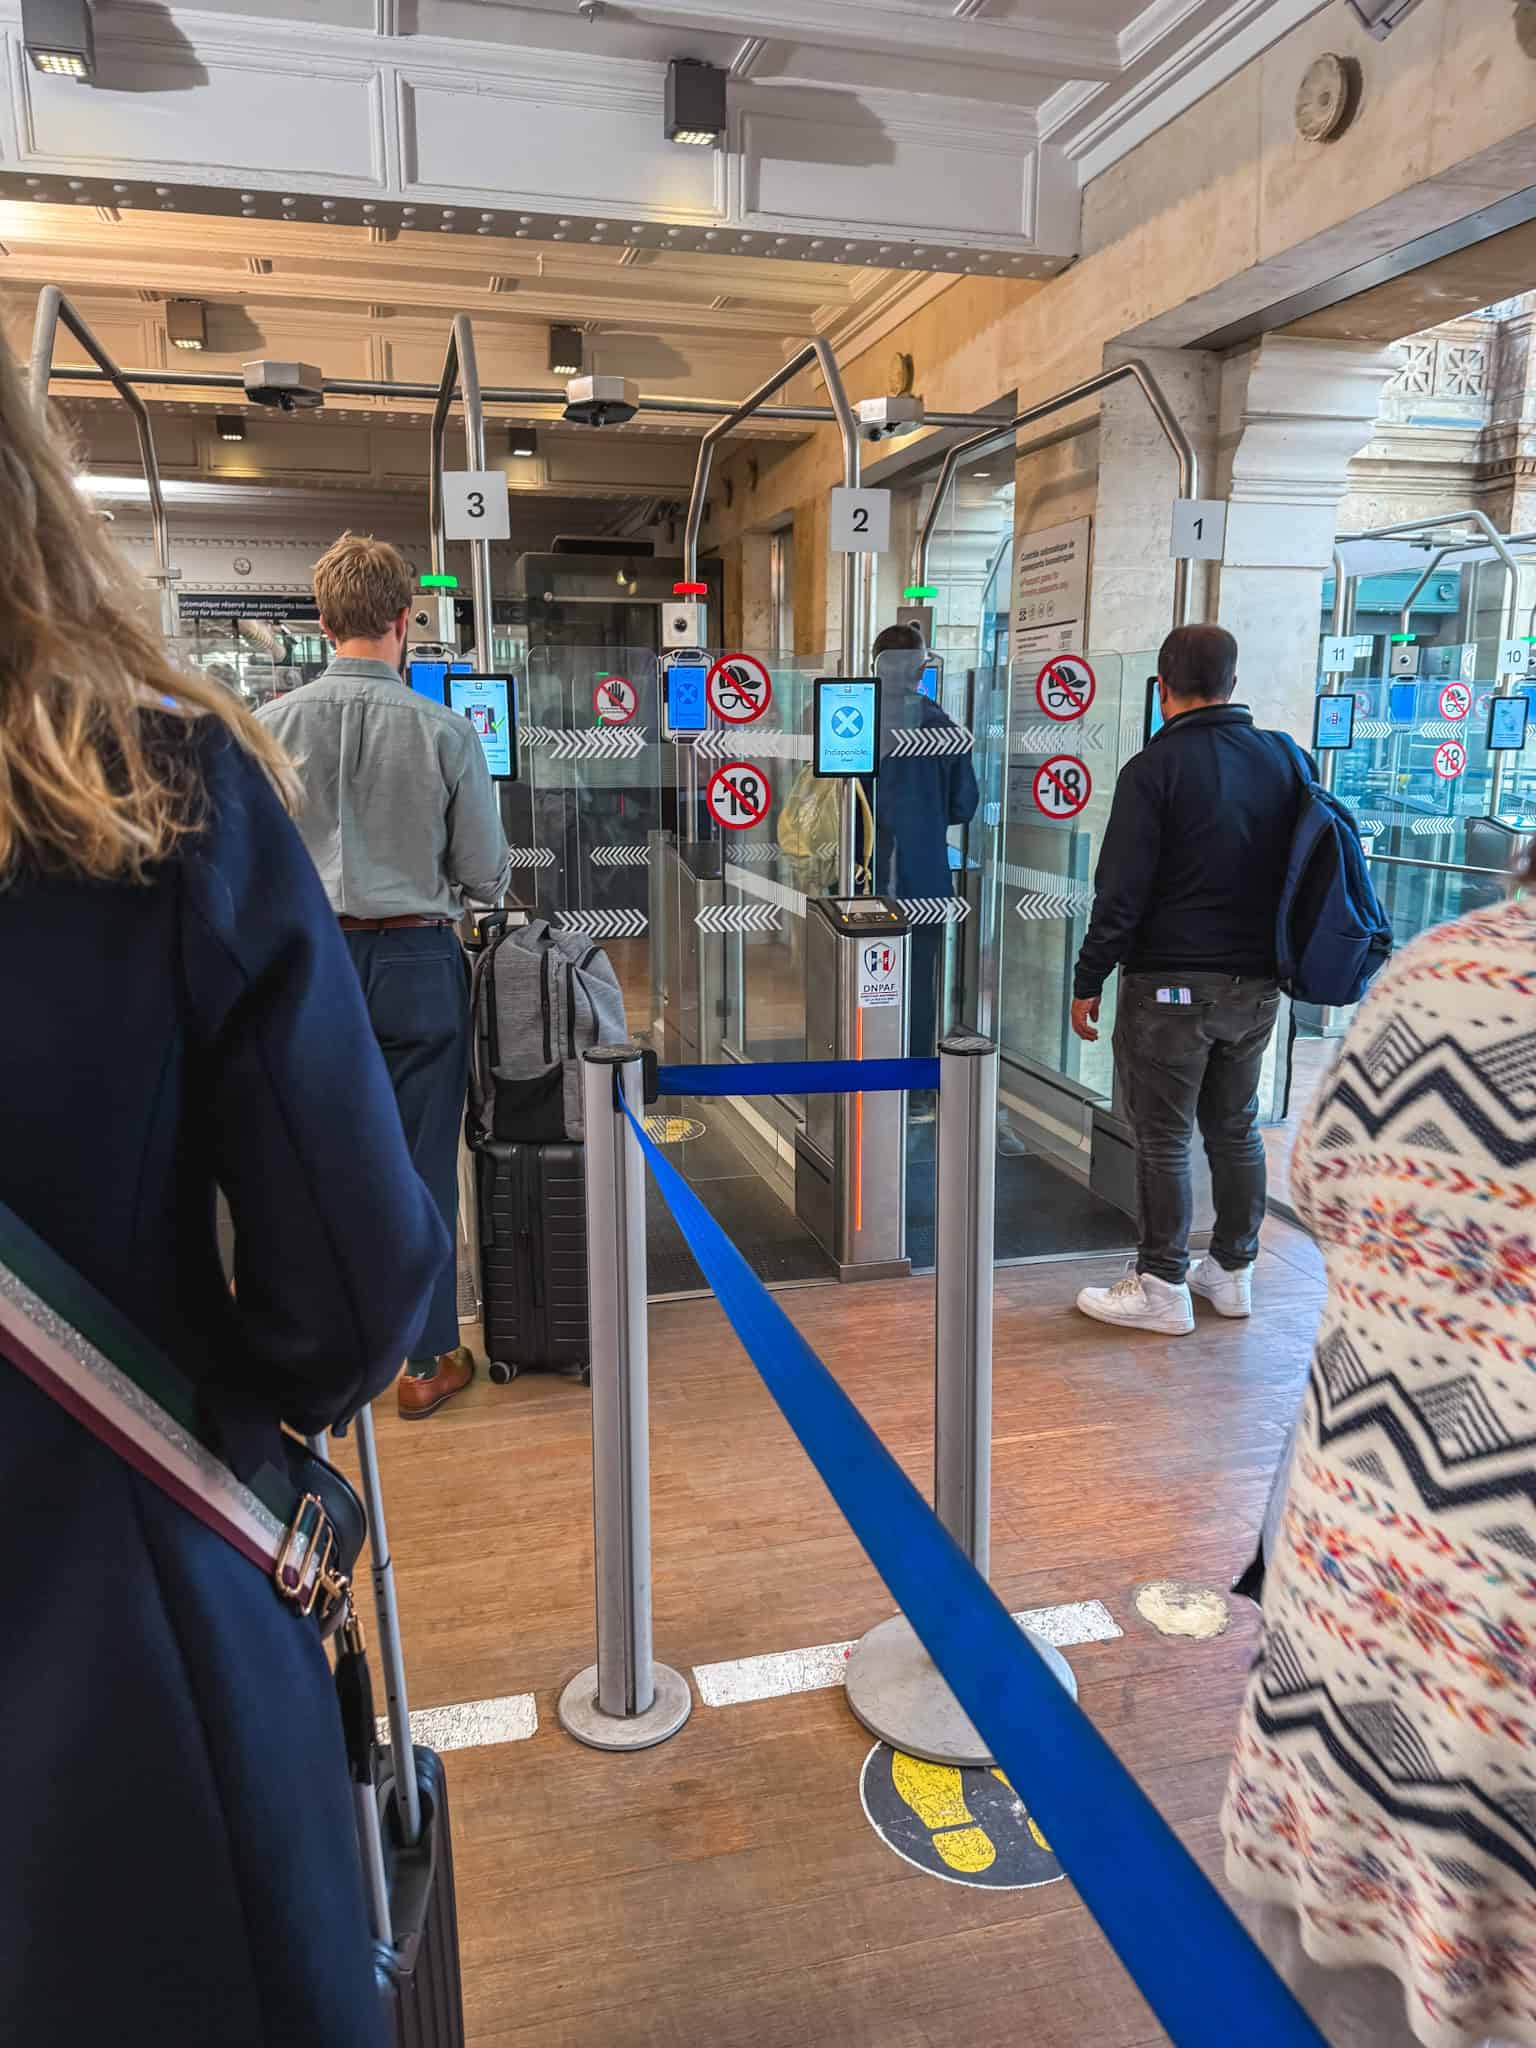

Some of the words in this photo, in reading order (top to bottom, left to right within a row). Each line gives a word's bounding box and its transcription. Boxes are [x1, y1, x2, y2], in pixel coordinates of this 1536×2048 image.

[467, 492, 485, 518] 3
[852, 508, 869, 532] 2
[1193, 518, 1204, 540] 1
[1332, 648, 1344, 661] 11
[1507, 650, 1522, 663] 10
[1438, 749, 1460, 770] -18
[714, 776, 759, 816] -18
[1039, 768, 1081, 806] -18
[863, 984, 896, 993] DNPAF
